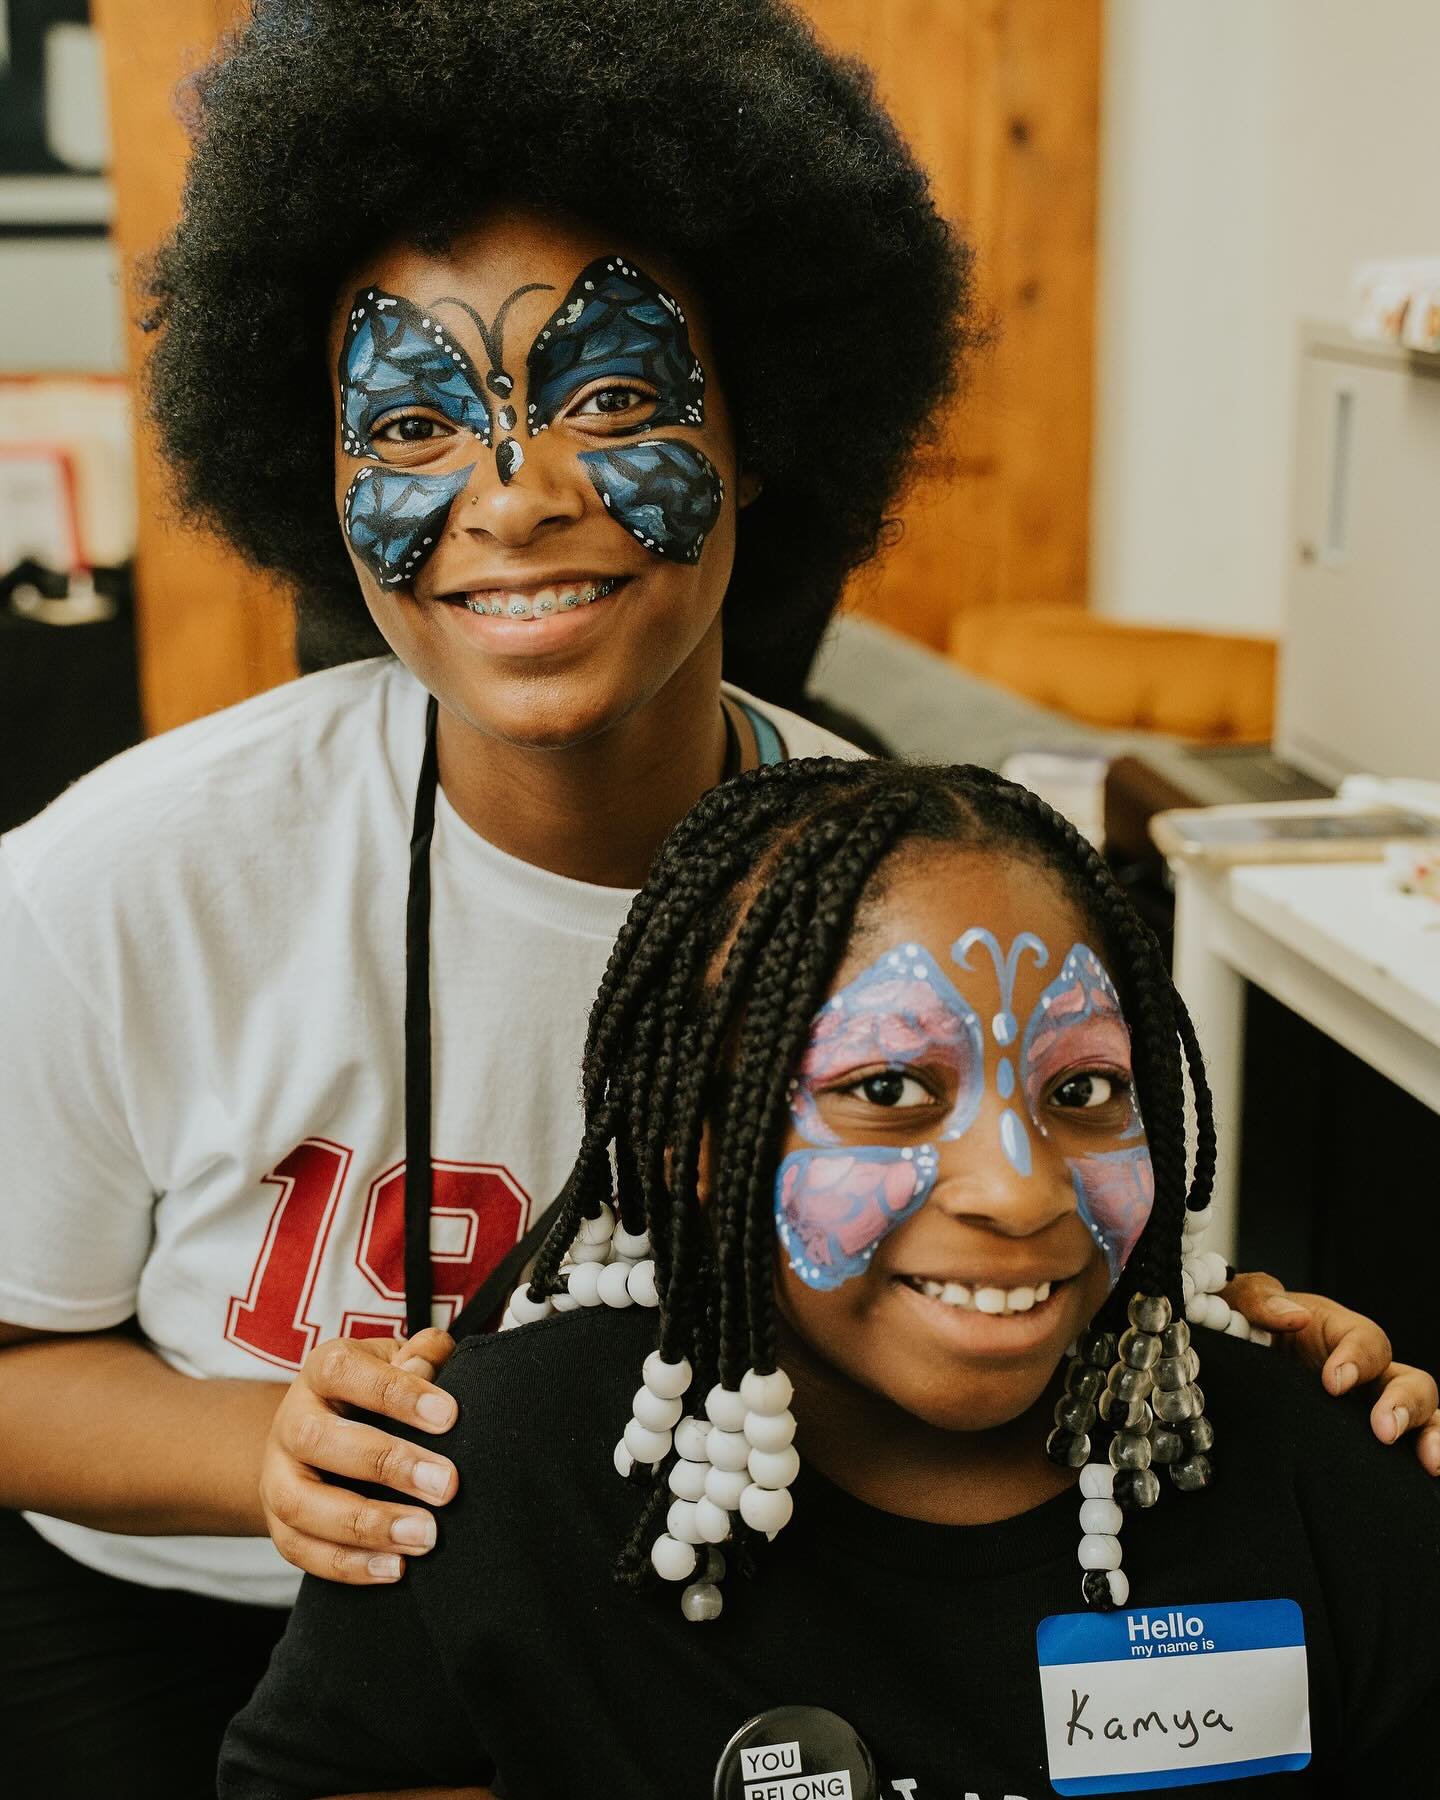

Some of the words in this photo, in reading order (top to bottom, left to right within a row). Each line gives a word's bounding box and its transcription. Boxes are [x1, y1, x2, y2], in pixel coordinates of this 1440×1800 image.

[224, 1136, 532, 1373] 19
[1127, 1612, 1204, 1641] Hello
[1131, 1645, 1153, 1658] my
[1158, 1641, 1198, 1654] name
[1202, 1637, 1215, 1650] is
[1066, 1689, 1234, 1748] Kamya
[747, 1749, 795, 1774] YOU
